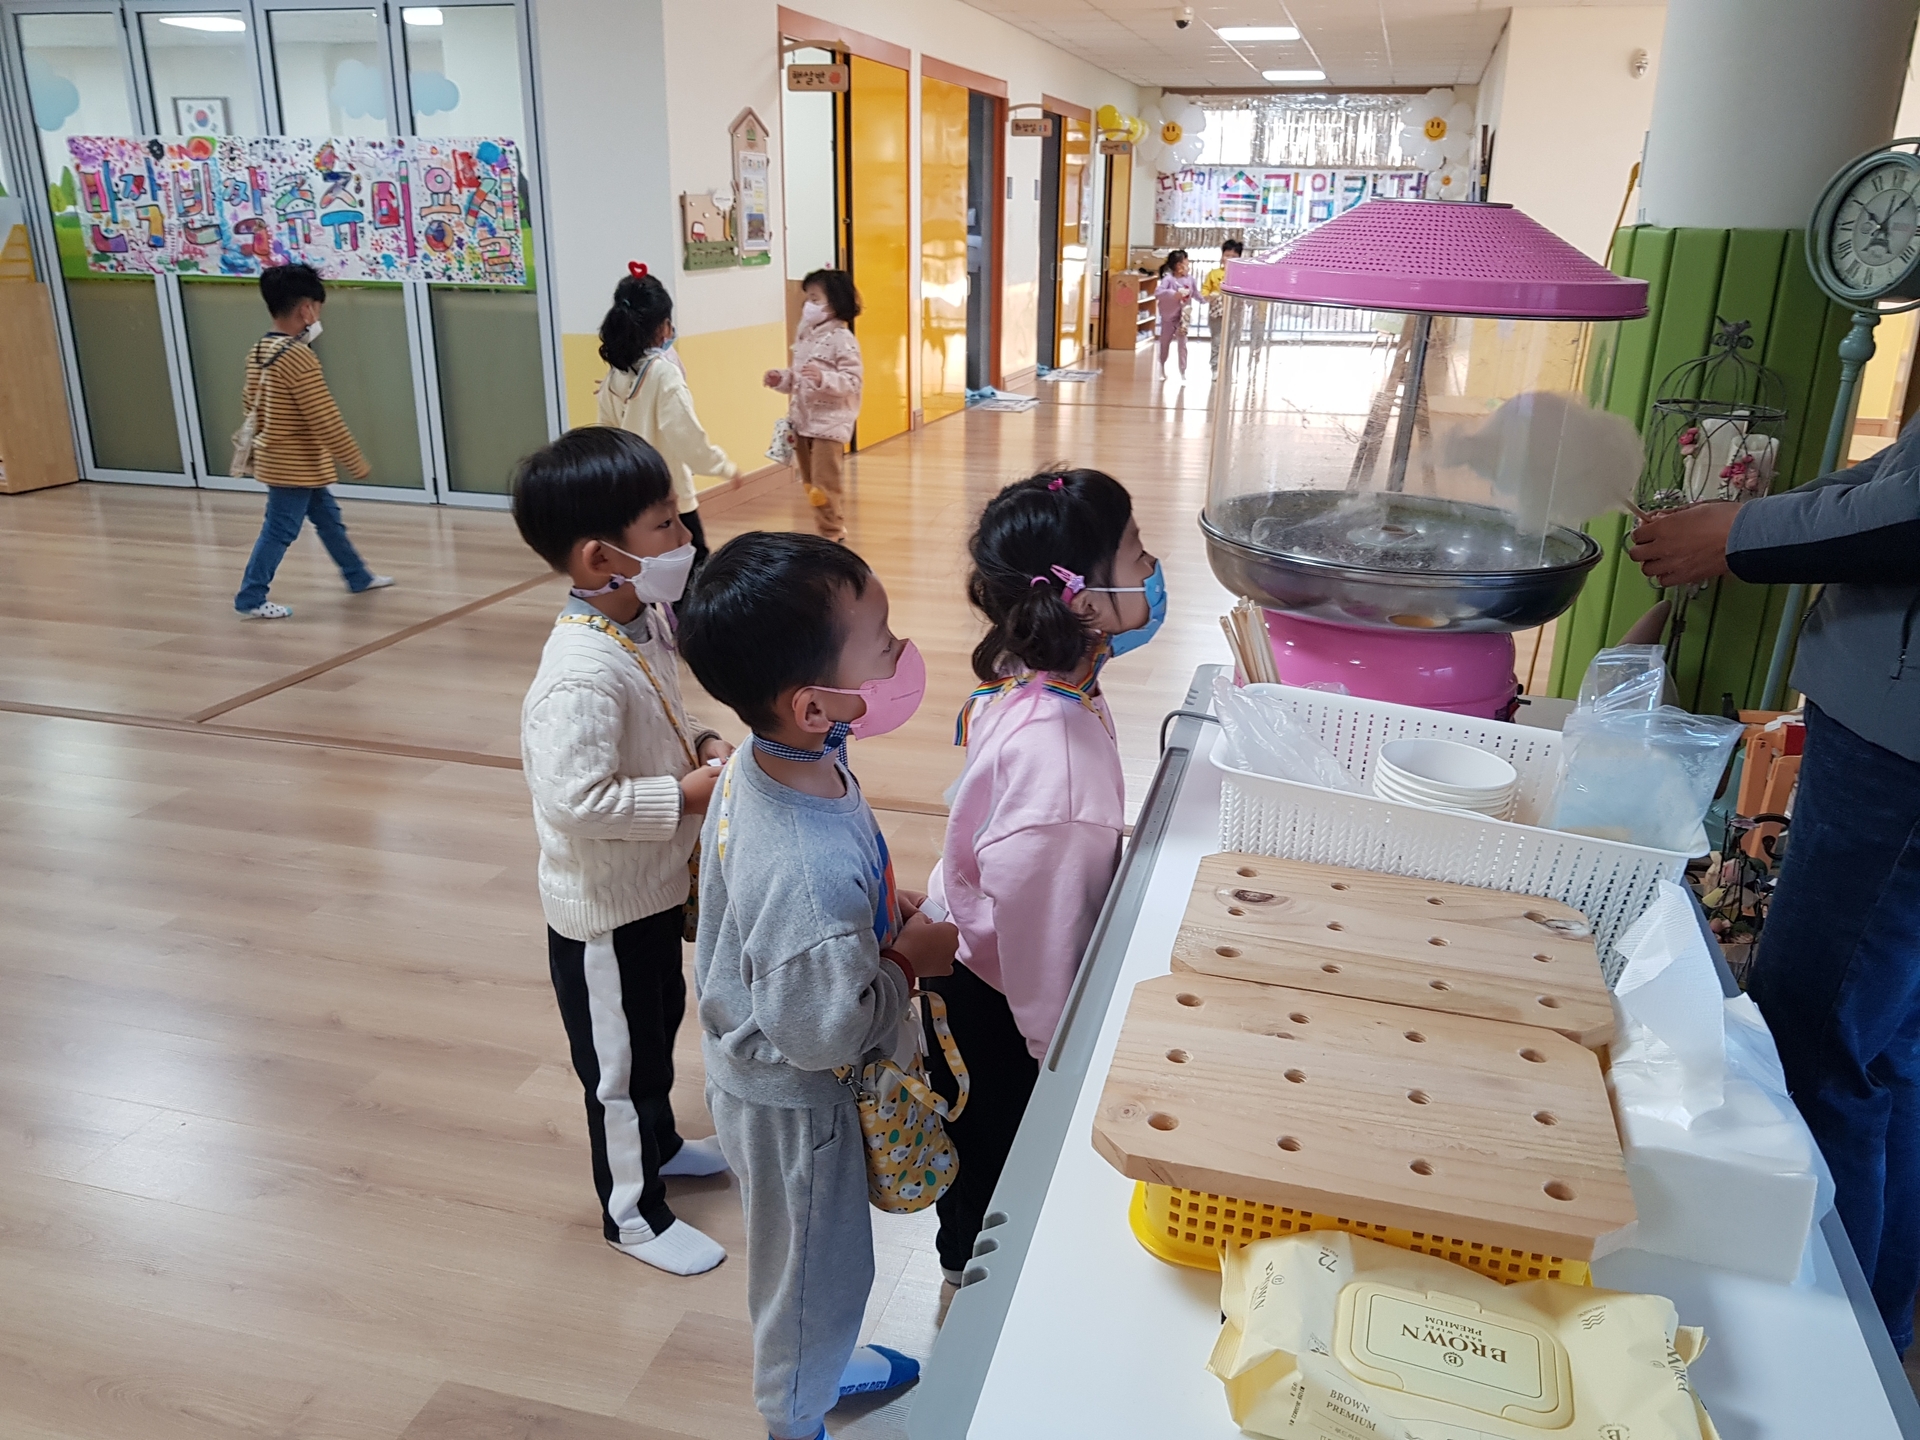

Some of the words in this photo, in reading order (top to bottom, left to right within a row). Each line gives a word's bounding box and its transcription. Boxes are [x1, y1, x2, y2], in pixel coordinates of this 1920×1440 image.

[1318, 1251, 1338, 1273] 72
[1424, 1324, 1454, 1335] WIPES
[1425, 1315, 1482, 1337] PREMIUM
[1401, 1323, 1508, 1364] BROWN
[1458, 1333, 1483, 1343] BABY
[1329, 1389, 1371, 1414] BROWN
[1326, 1401, 1377, 1432] PREMIUM
